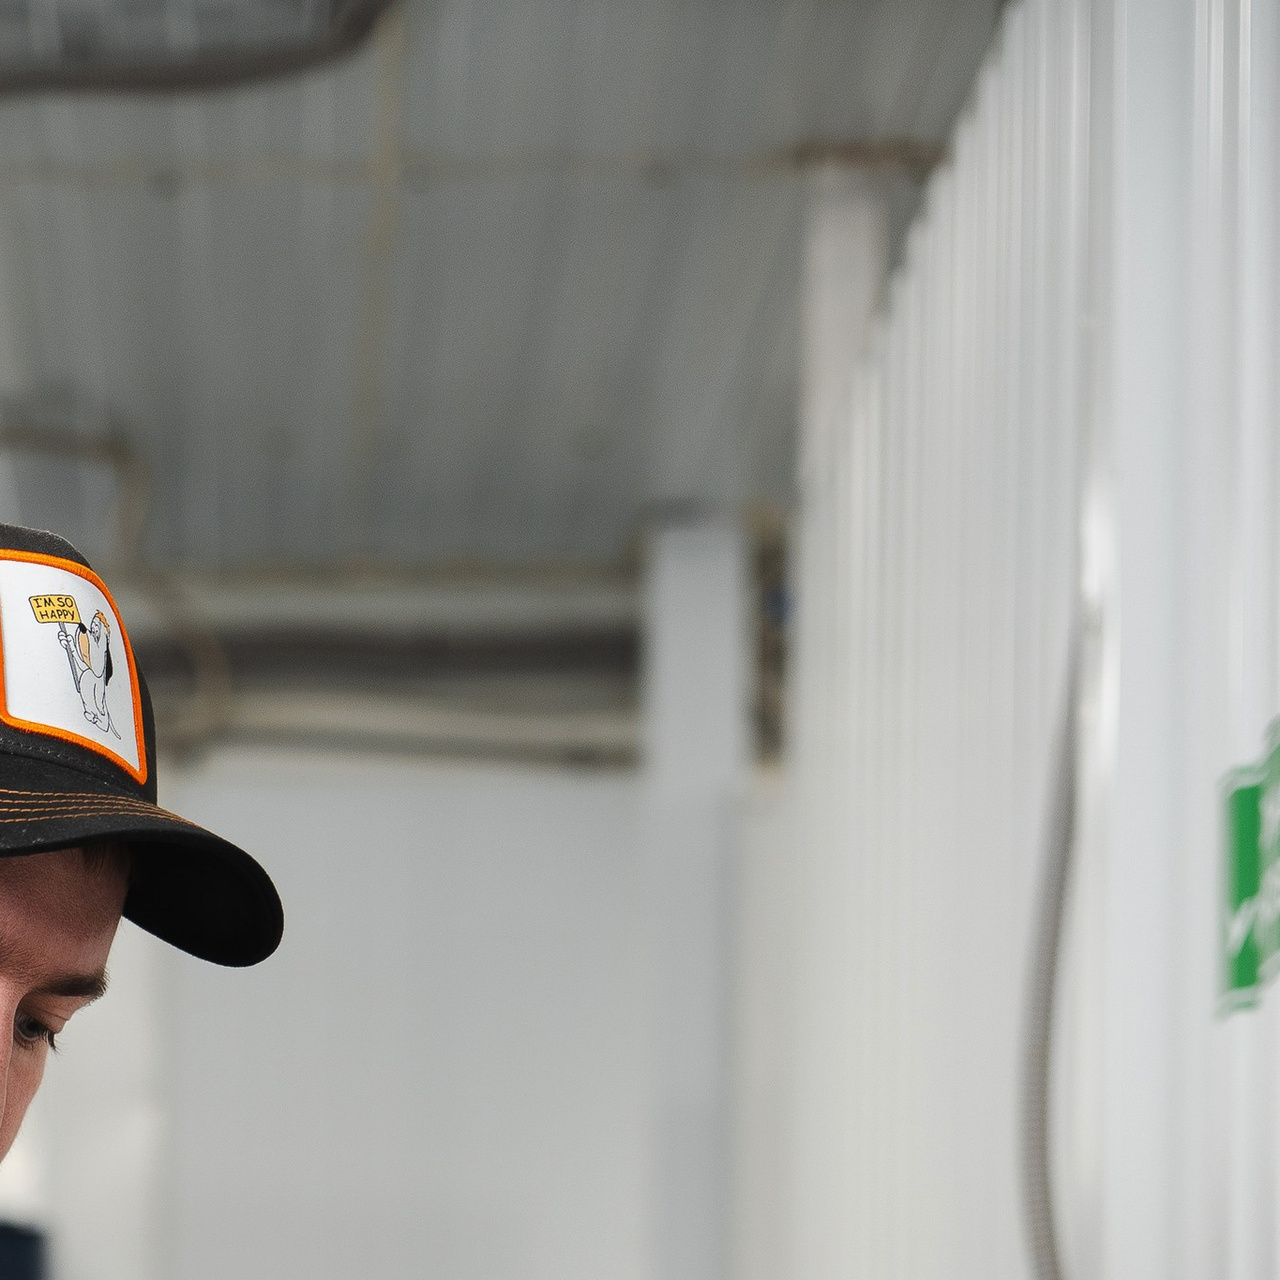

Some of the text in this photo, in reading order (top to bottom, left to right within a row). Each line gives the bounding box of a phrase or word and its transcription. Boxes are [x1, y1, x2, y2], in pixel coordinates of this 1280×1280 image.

[33, 597, 74, 608] I'M SO
[39, 609, 75, 621] HAPPY
